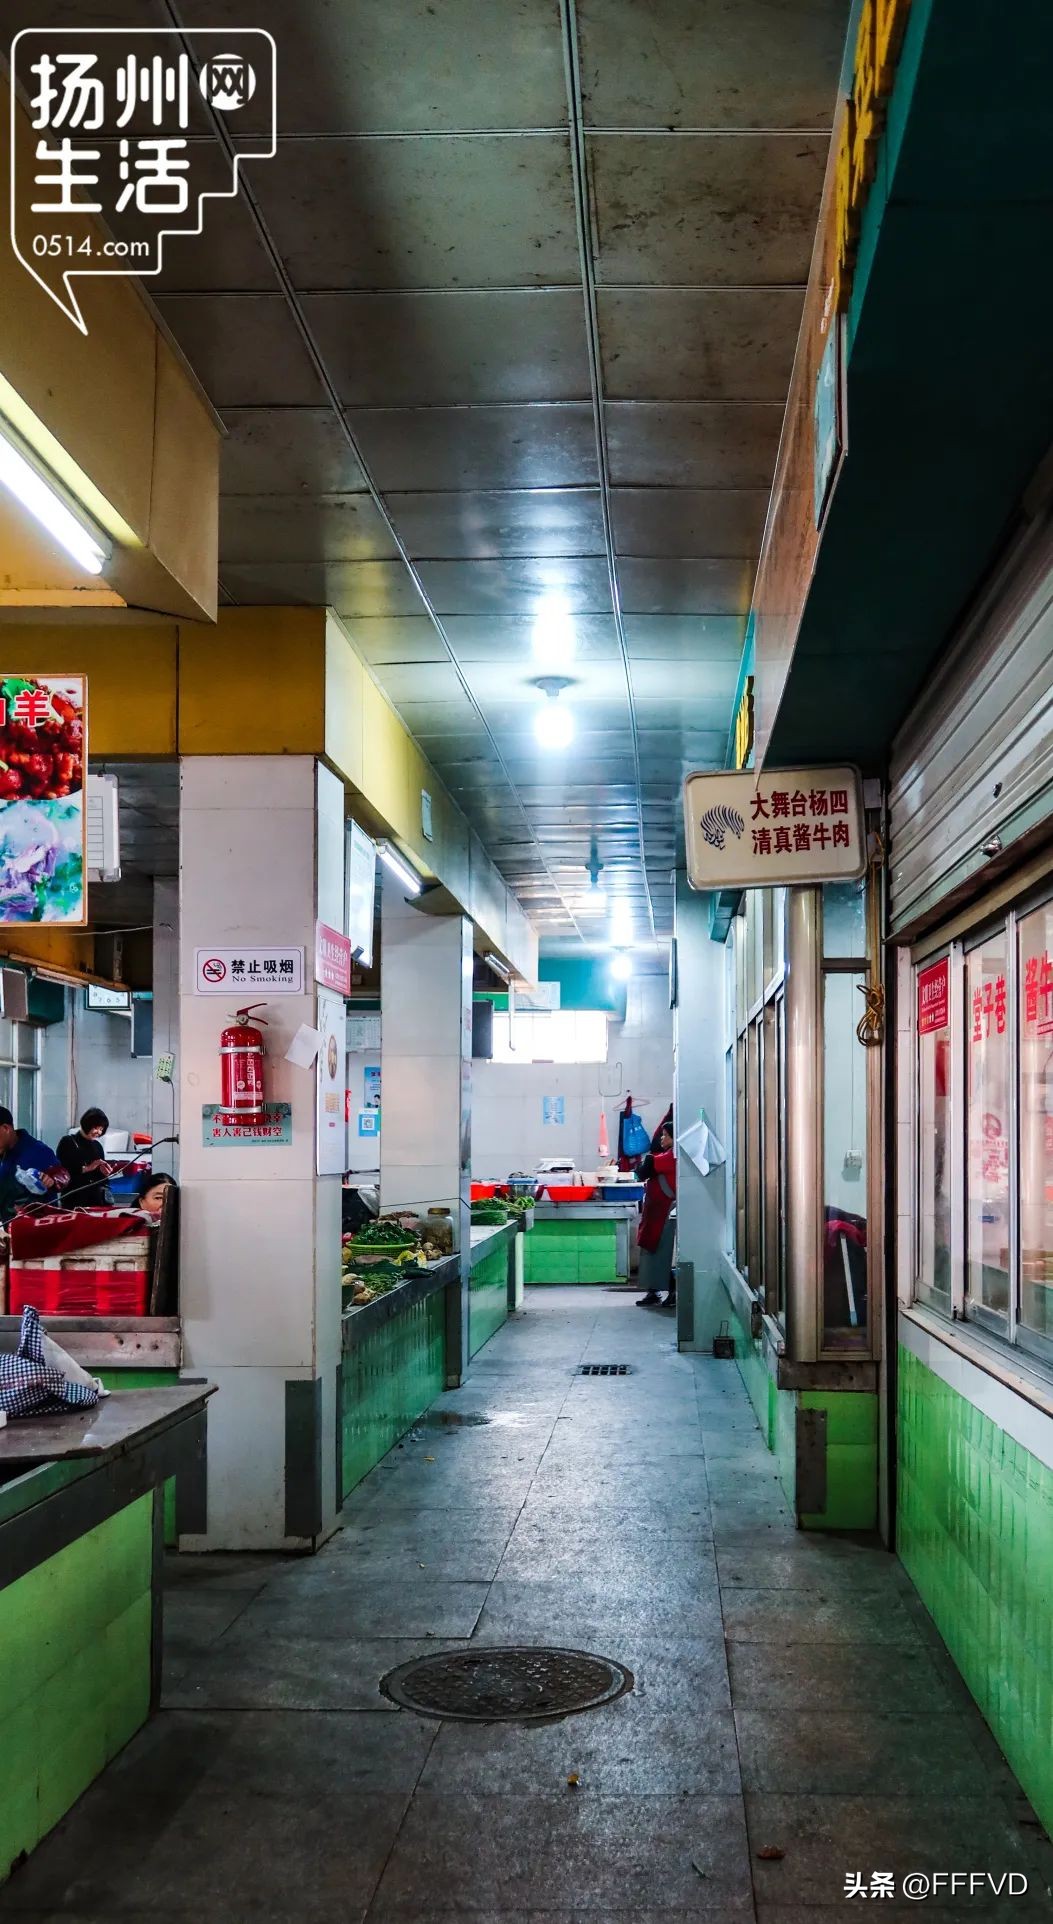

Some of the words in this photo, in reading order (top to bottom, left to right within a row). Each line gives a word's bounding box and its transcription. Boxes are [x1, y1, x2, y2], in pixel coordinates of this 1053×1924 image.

[0, 689, 50, 727] 羊
[750, 789, 848, 820] 大舞台杨四
[751, 820, 850, 855] 清真酱牛肉
[231, 959, 294, 974] 禁止吸烟
[250, 975, 294, 983] Smoking
